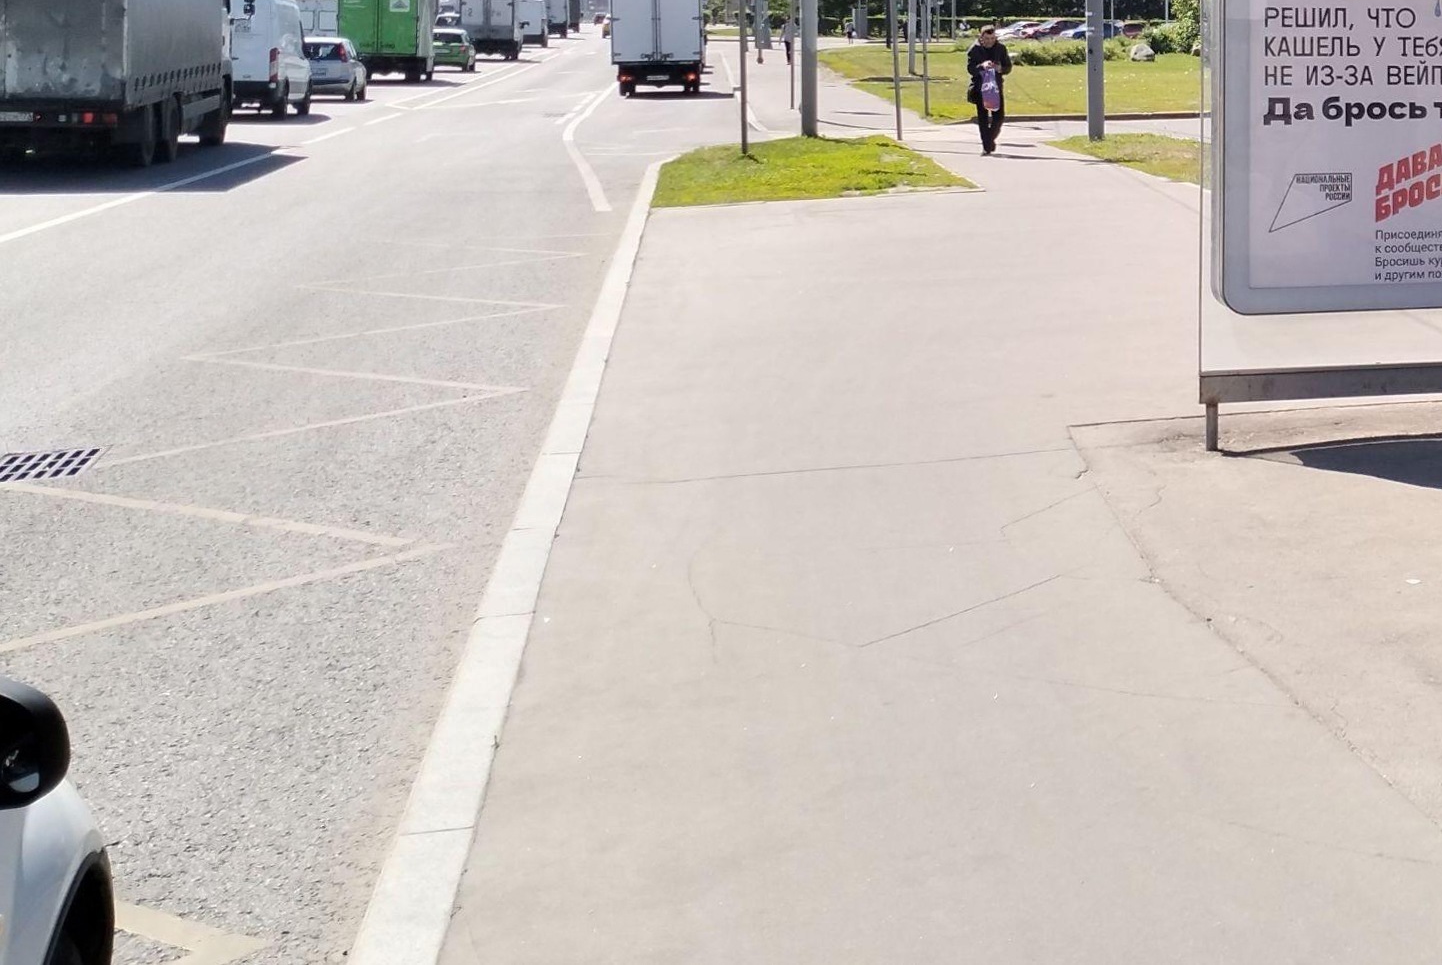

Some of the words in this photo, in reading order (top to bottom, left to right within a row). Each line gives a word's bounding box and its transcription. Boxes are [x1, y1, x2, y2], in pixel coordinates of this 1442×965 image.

[1264, 6, 1354, 31] РЕШИЛ,
[1367, 7, 1417, 29] ЧТО
[1264, 36, 1361, 57] КАШЕЛЬ
[1373, 36, 1386, 57] У
[1264, 65, 1293, 86] НЕ
[1306, 65, 1374, 86] ИЗ-ЗА
[1263, 97, 1315, 126] Да
[1321, 96, 1427, 127] брось
[1296, 174, 1351, 184] НАЦИОНАЛЬНЫЕ
[1319, 184, 1351, 192] ПРОЕКТЫ
[1325, 192, 1351, 201] РОССИИ
[1375, 245, 1382, 254] к
[1375, 256, 1426, 269] Бросишь
[1375, 272, 1382, 280] и
[1384, 270, 1425, 282] другим
